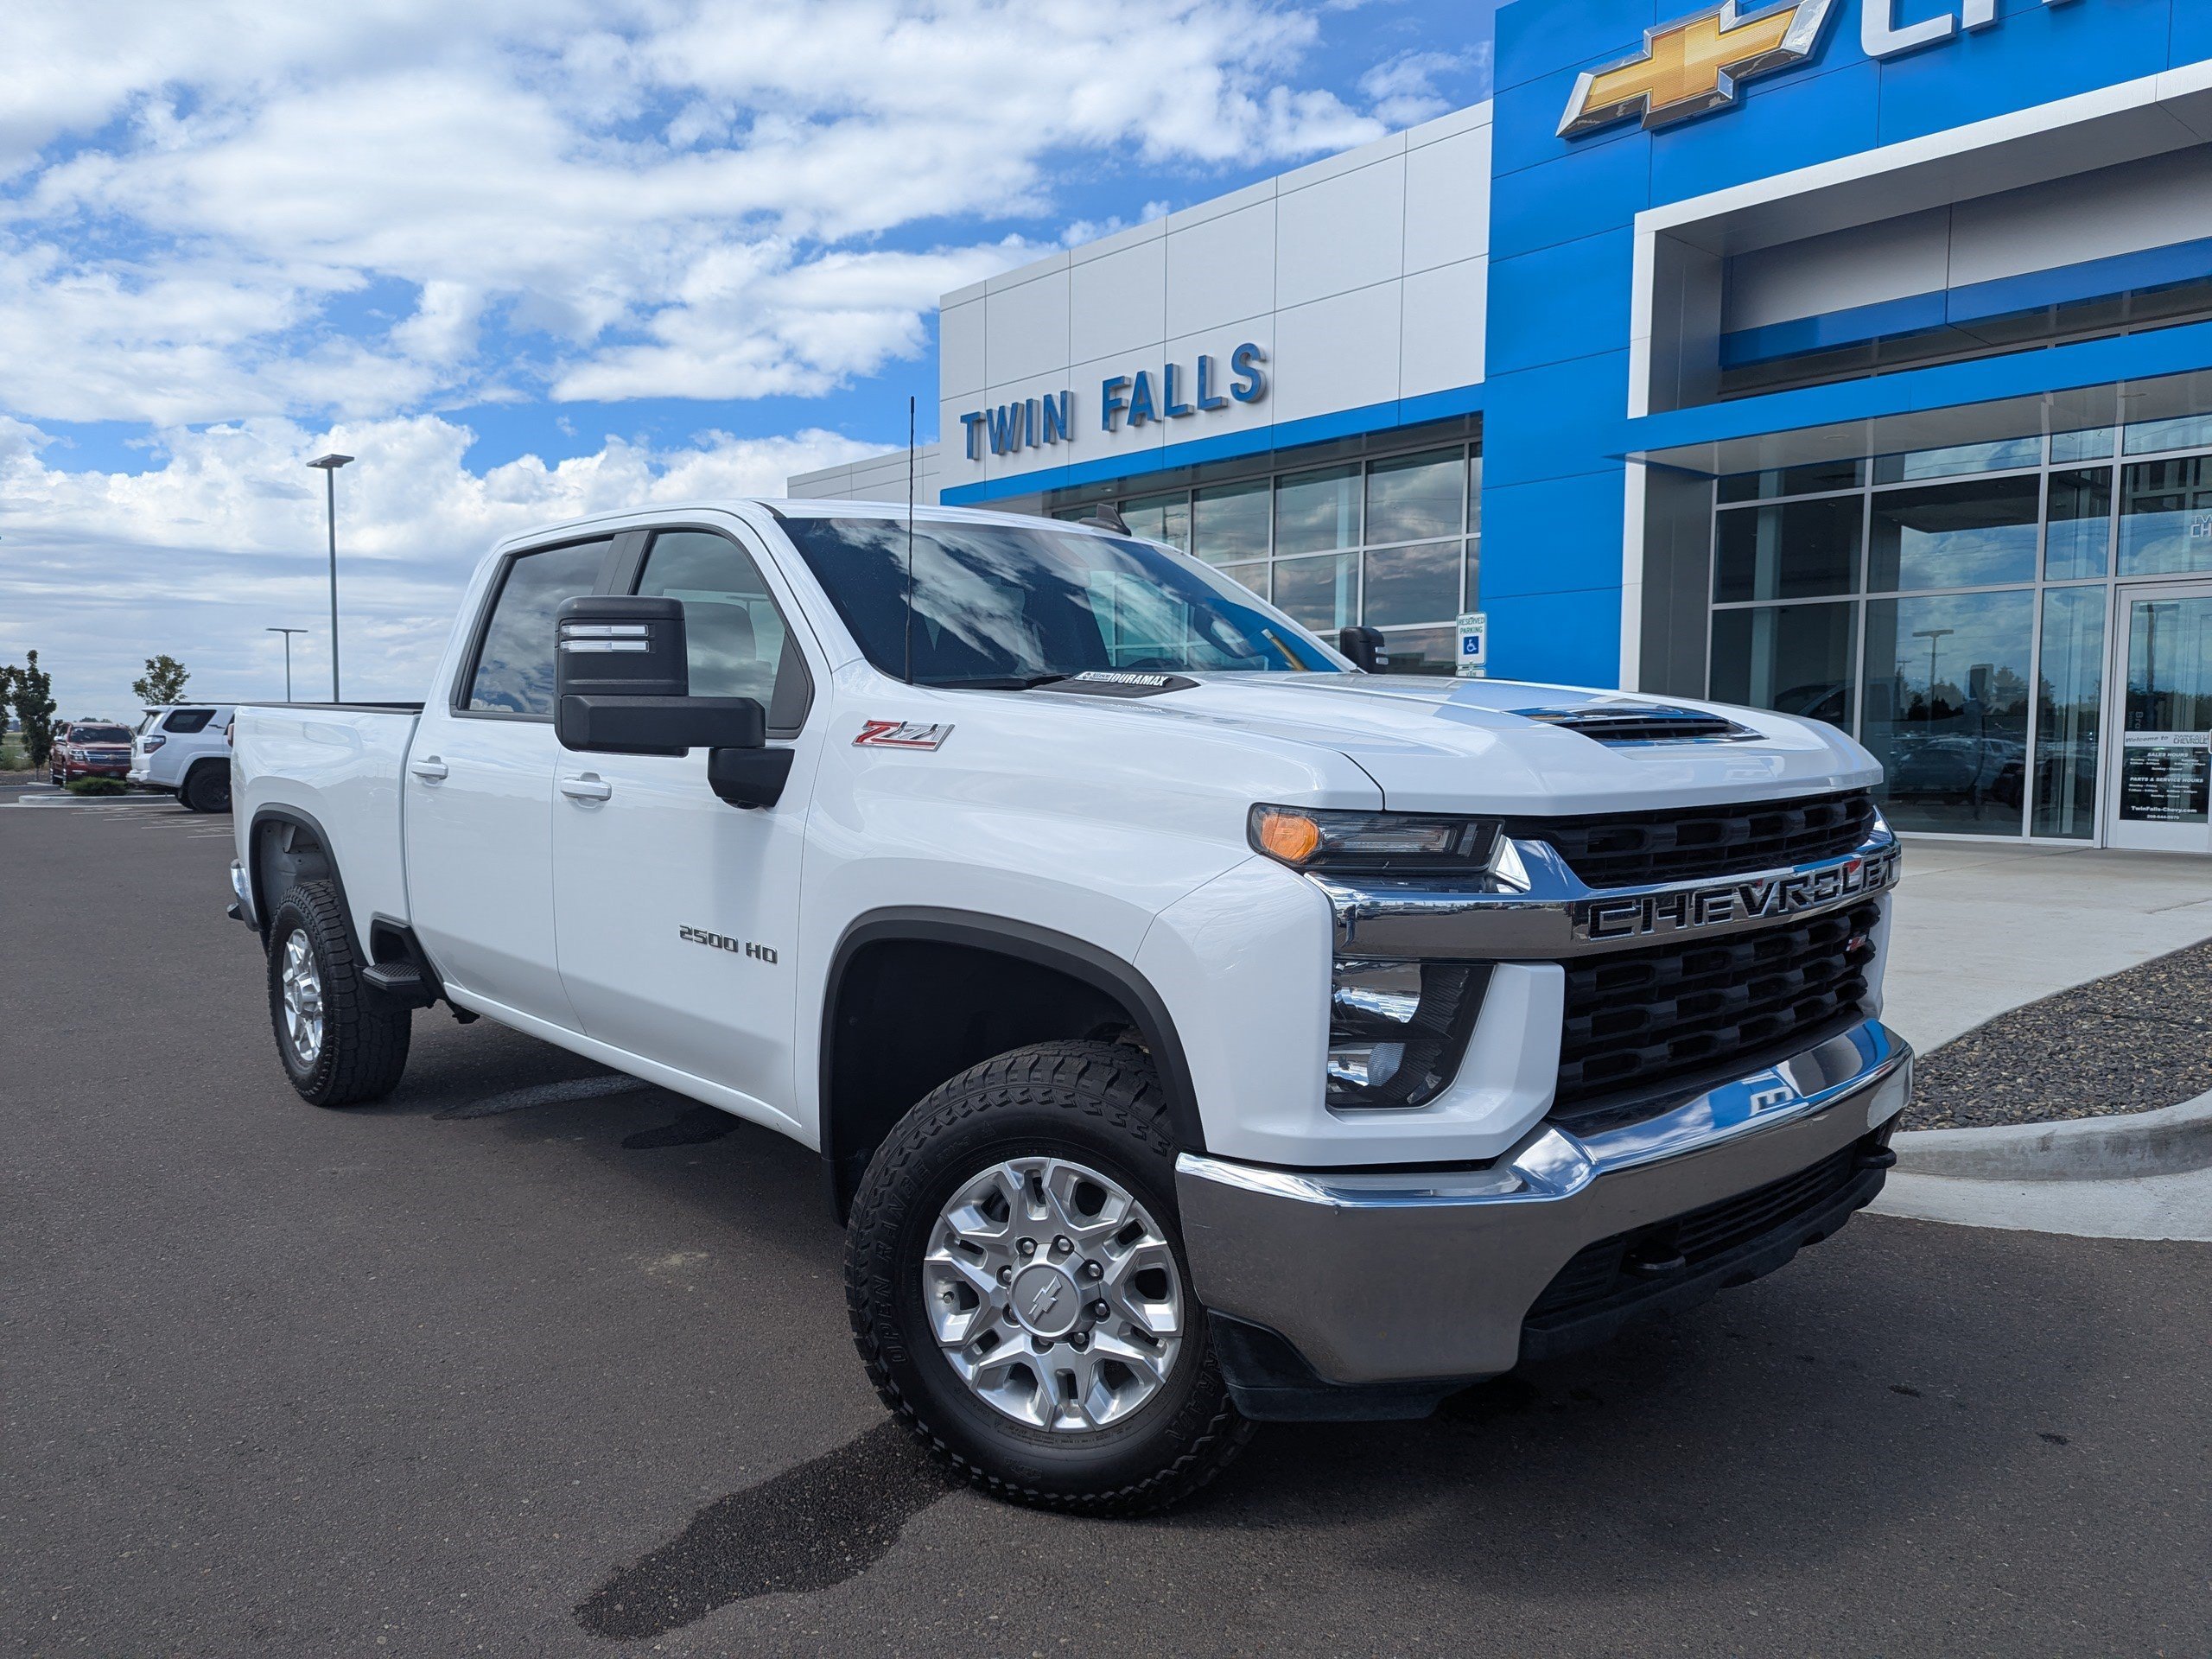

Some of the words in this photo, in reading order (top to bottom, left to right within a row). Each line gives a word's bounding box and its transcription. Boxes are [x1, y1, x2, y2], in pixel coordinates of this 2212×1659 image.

[960, 391, 1074, 461] TWIN
[1102, 342, 1267, 433] FALLS
[1458, 617, 1484, 626] RESERVED
[1110, 673, 1170, 686] DURAMAX
[1588, 852, 1898, 942] CHEVROLET
[679, 925, 738, 953] 2500
[746, 941, 778, 964] HD
